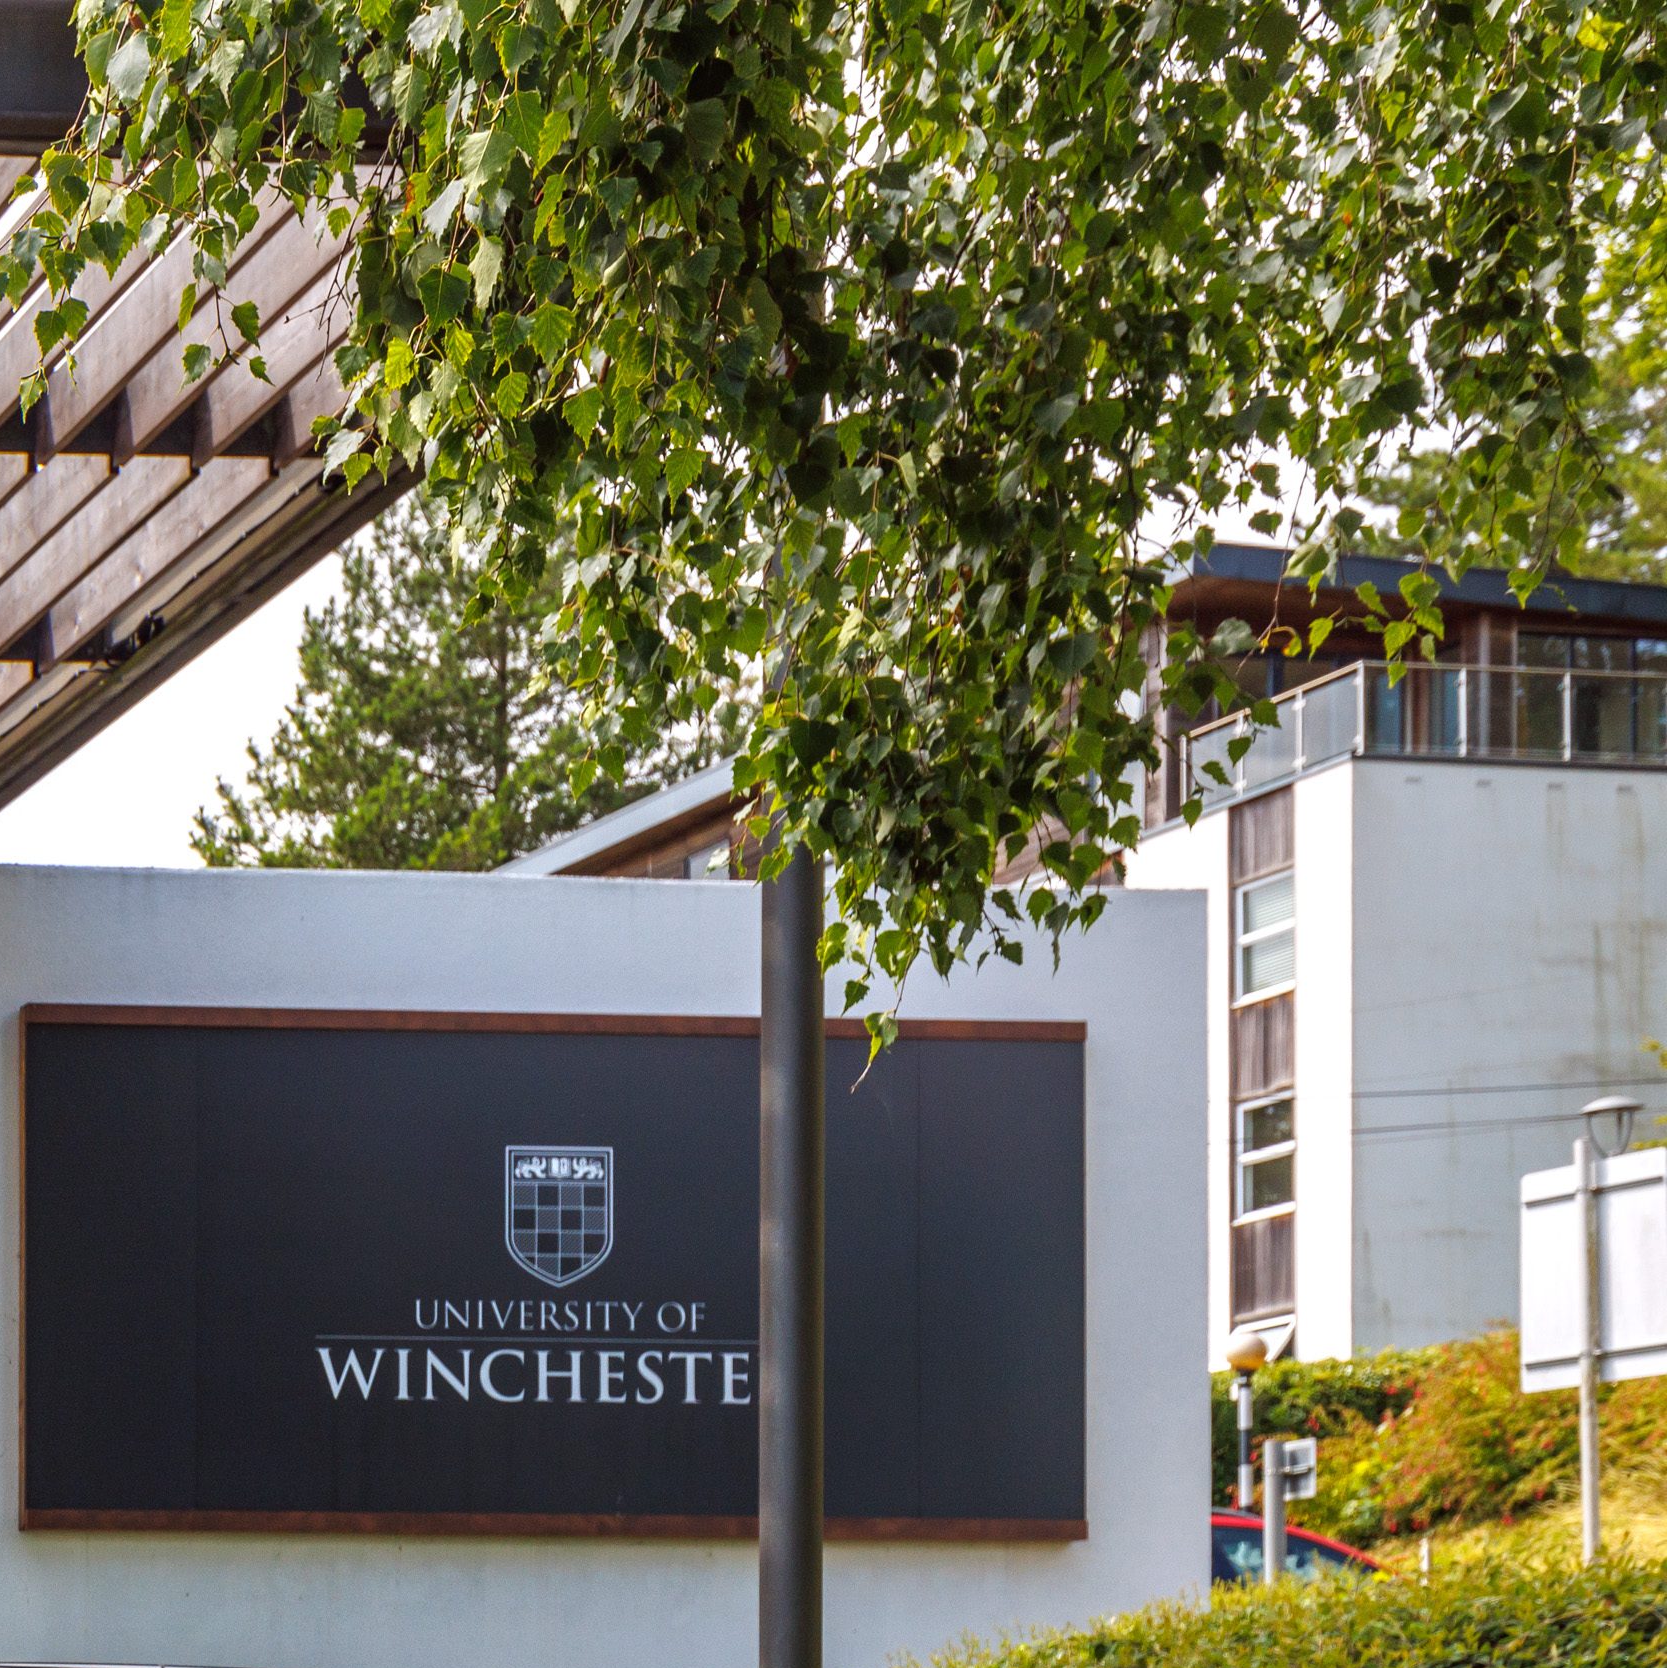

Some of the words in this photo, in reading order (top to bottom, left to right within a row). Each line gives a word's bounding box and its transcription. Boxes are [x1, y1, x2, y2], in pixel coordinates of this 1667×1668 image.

[415, 1299, 643, 1331] UNIVERSITY
[656, 1301, 705, 1333] OF
[316, 1347, 753, 1405] WINCHESTE
